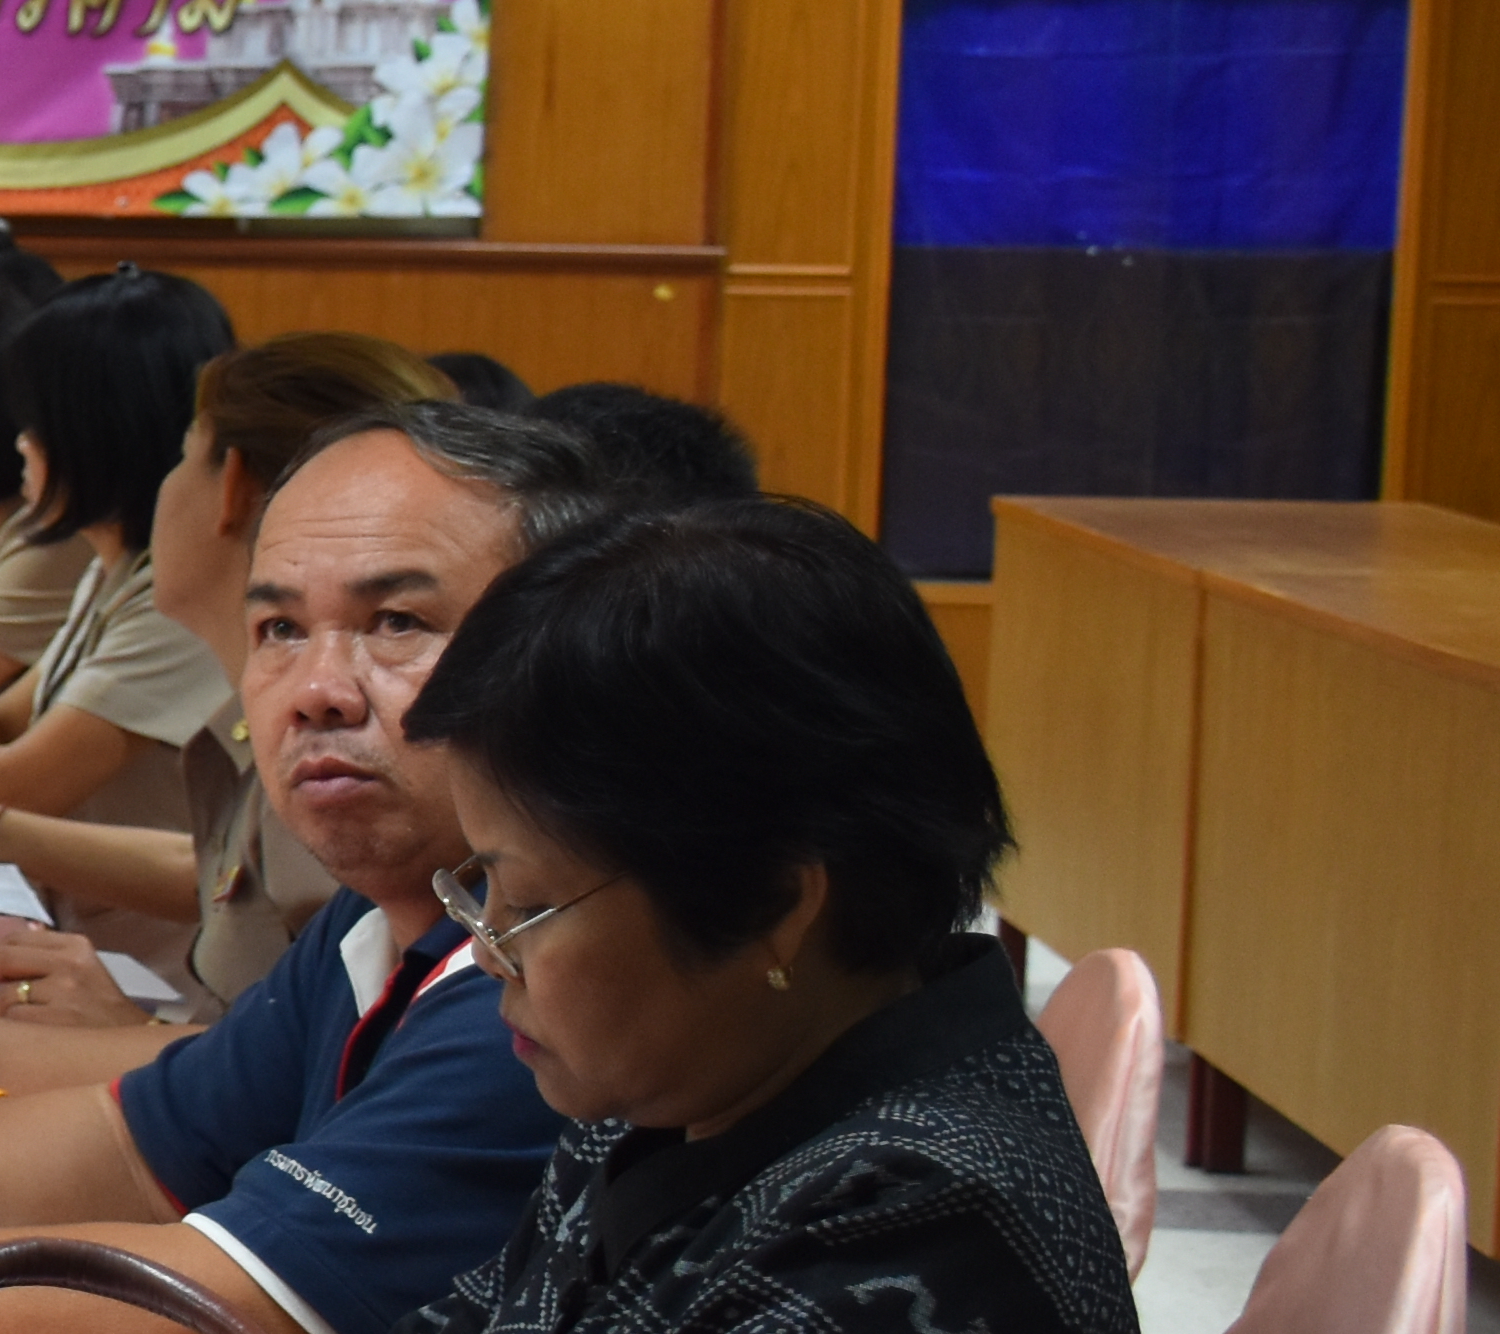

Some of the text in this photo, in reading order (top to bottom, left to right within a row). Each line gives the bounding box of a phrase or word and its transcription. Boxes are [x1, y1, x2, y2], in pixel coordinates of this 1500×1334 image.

[263, 1149, 377, 1234] กรมการพัฒนาชุมชน
